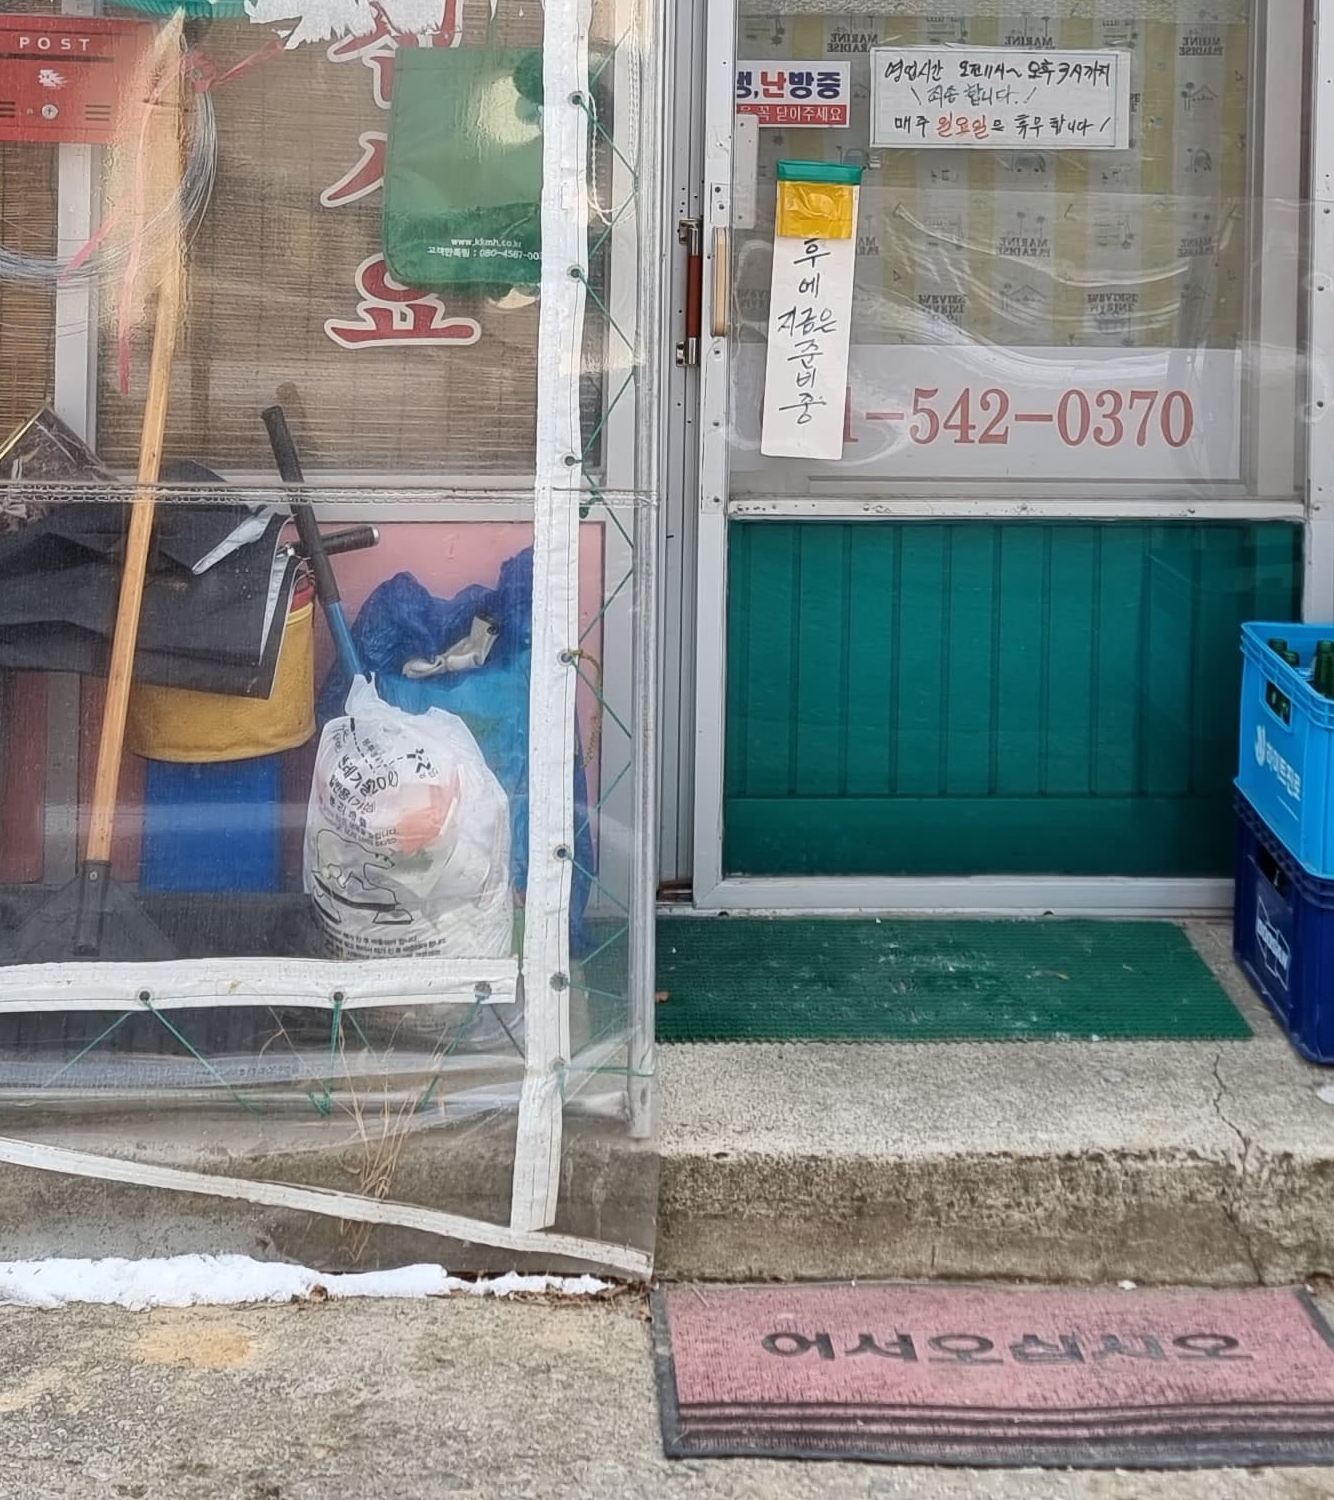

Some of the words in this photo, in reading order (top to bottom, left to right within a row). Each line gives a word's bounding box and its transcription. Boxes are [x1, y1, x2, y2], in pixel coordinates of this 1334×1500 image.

[19, 36, 91, 51] POST
[884, 59, 944, 83] 영업시간
[894, 115, 930, 138] 매주
[843, 388, 1195, 449] 1-542-0370
